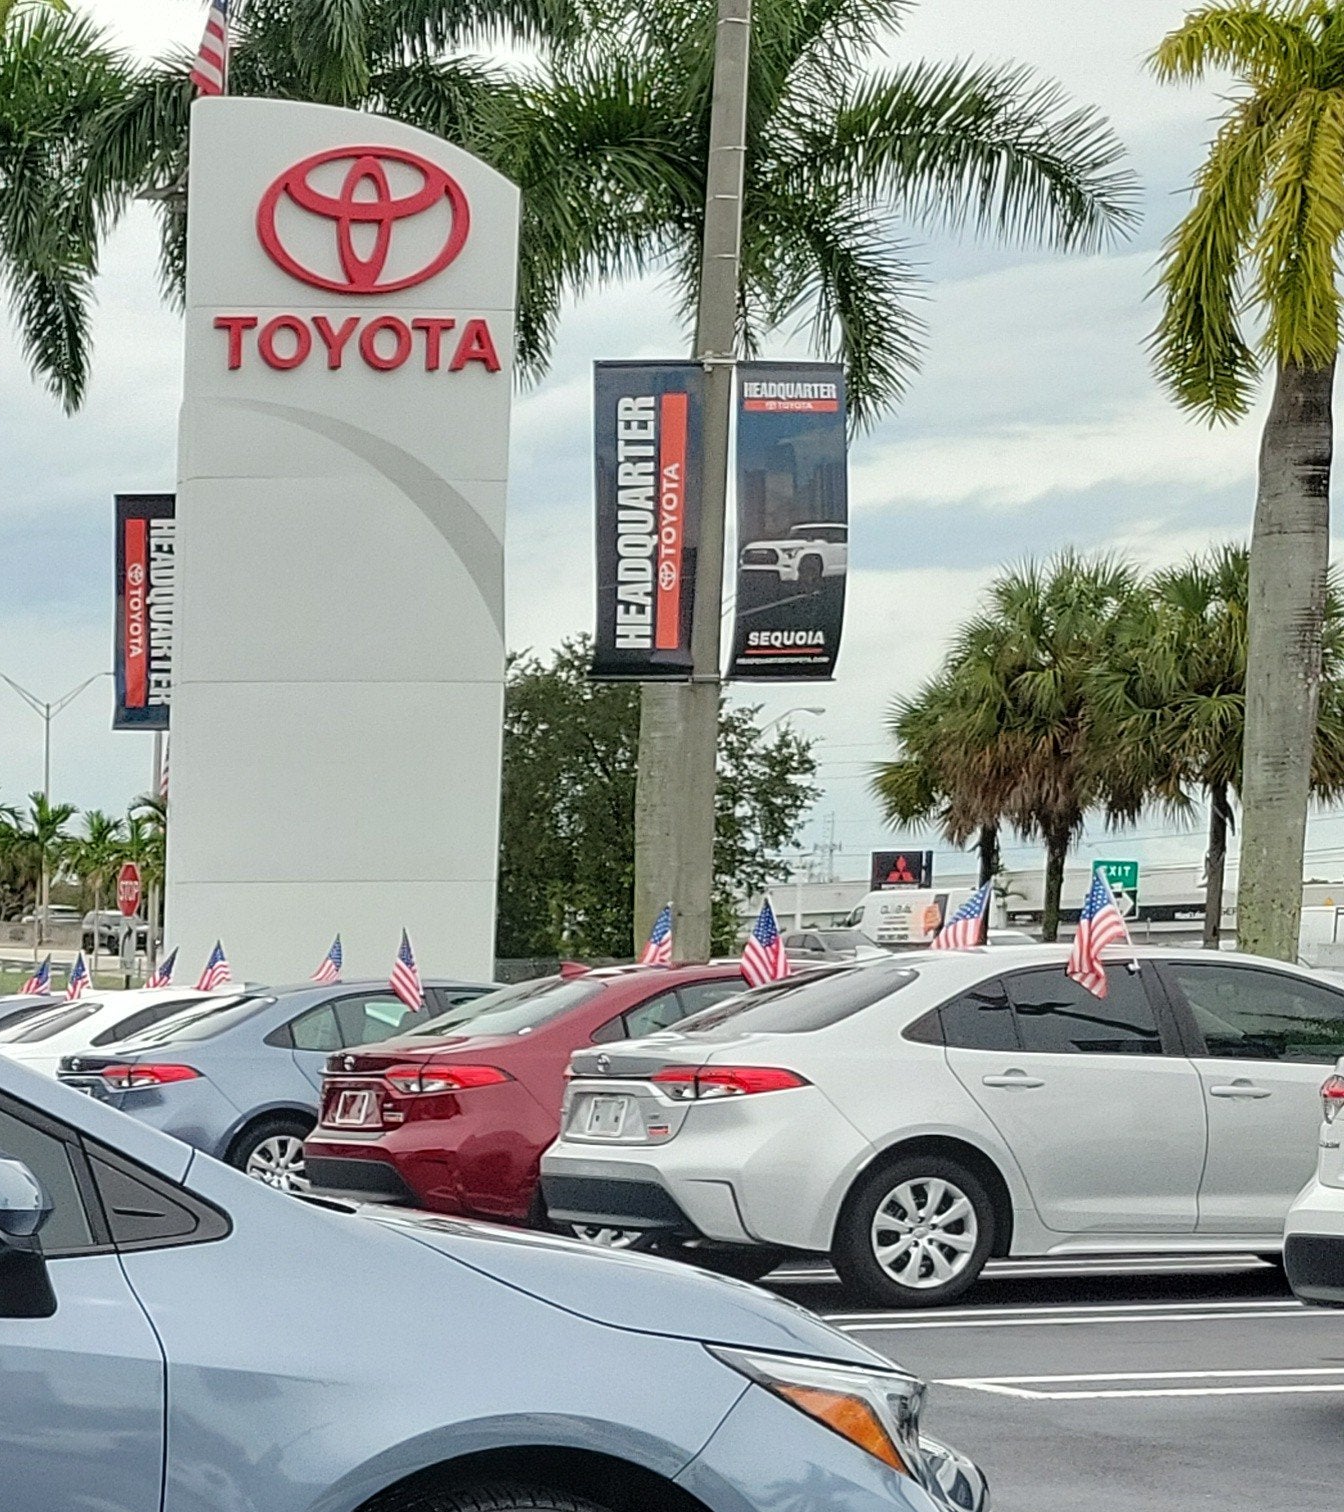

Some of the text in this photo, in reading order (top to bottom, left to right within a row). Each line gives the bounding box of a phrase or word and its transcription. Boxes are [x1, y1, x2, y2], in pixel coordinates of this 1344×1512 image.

[213, 315, 502, 372] TOYOTA
[743, 382, 837, 400] HEADQUARTER
[615, 396, 656, 649] HEADQUARTER
[660, 463, 680, 559] TOYOTA
[129, 588, 143, 658] TOYOTA
[748, 631, 825, 648] SEQUOIA
[120, 880, 139, 901] STOP
